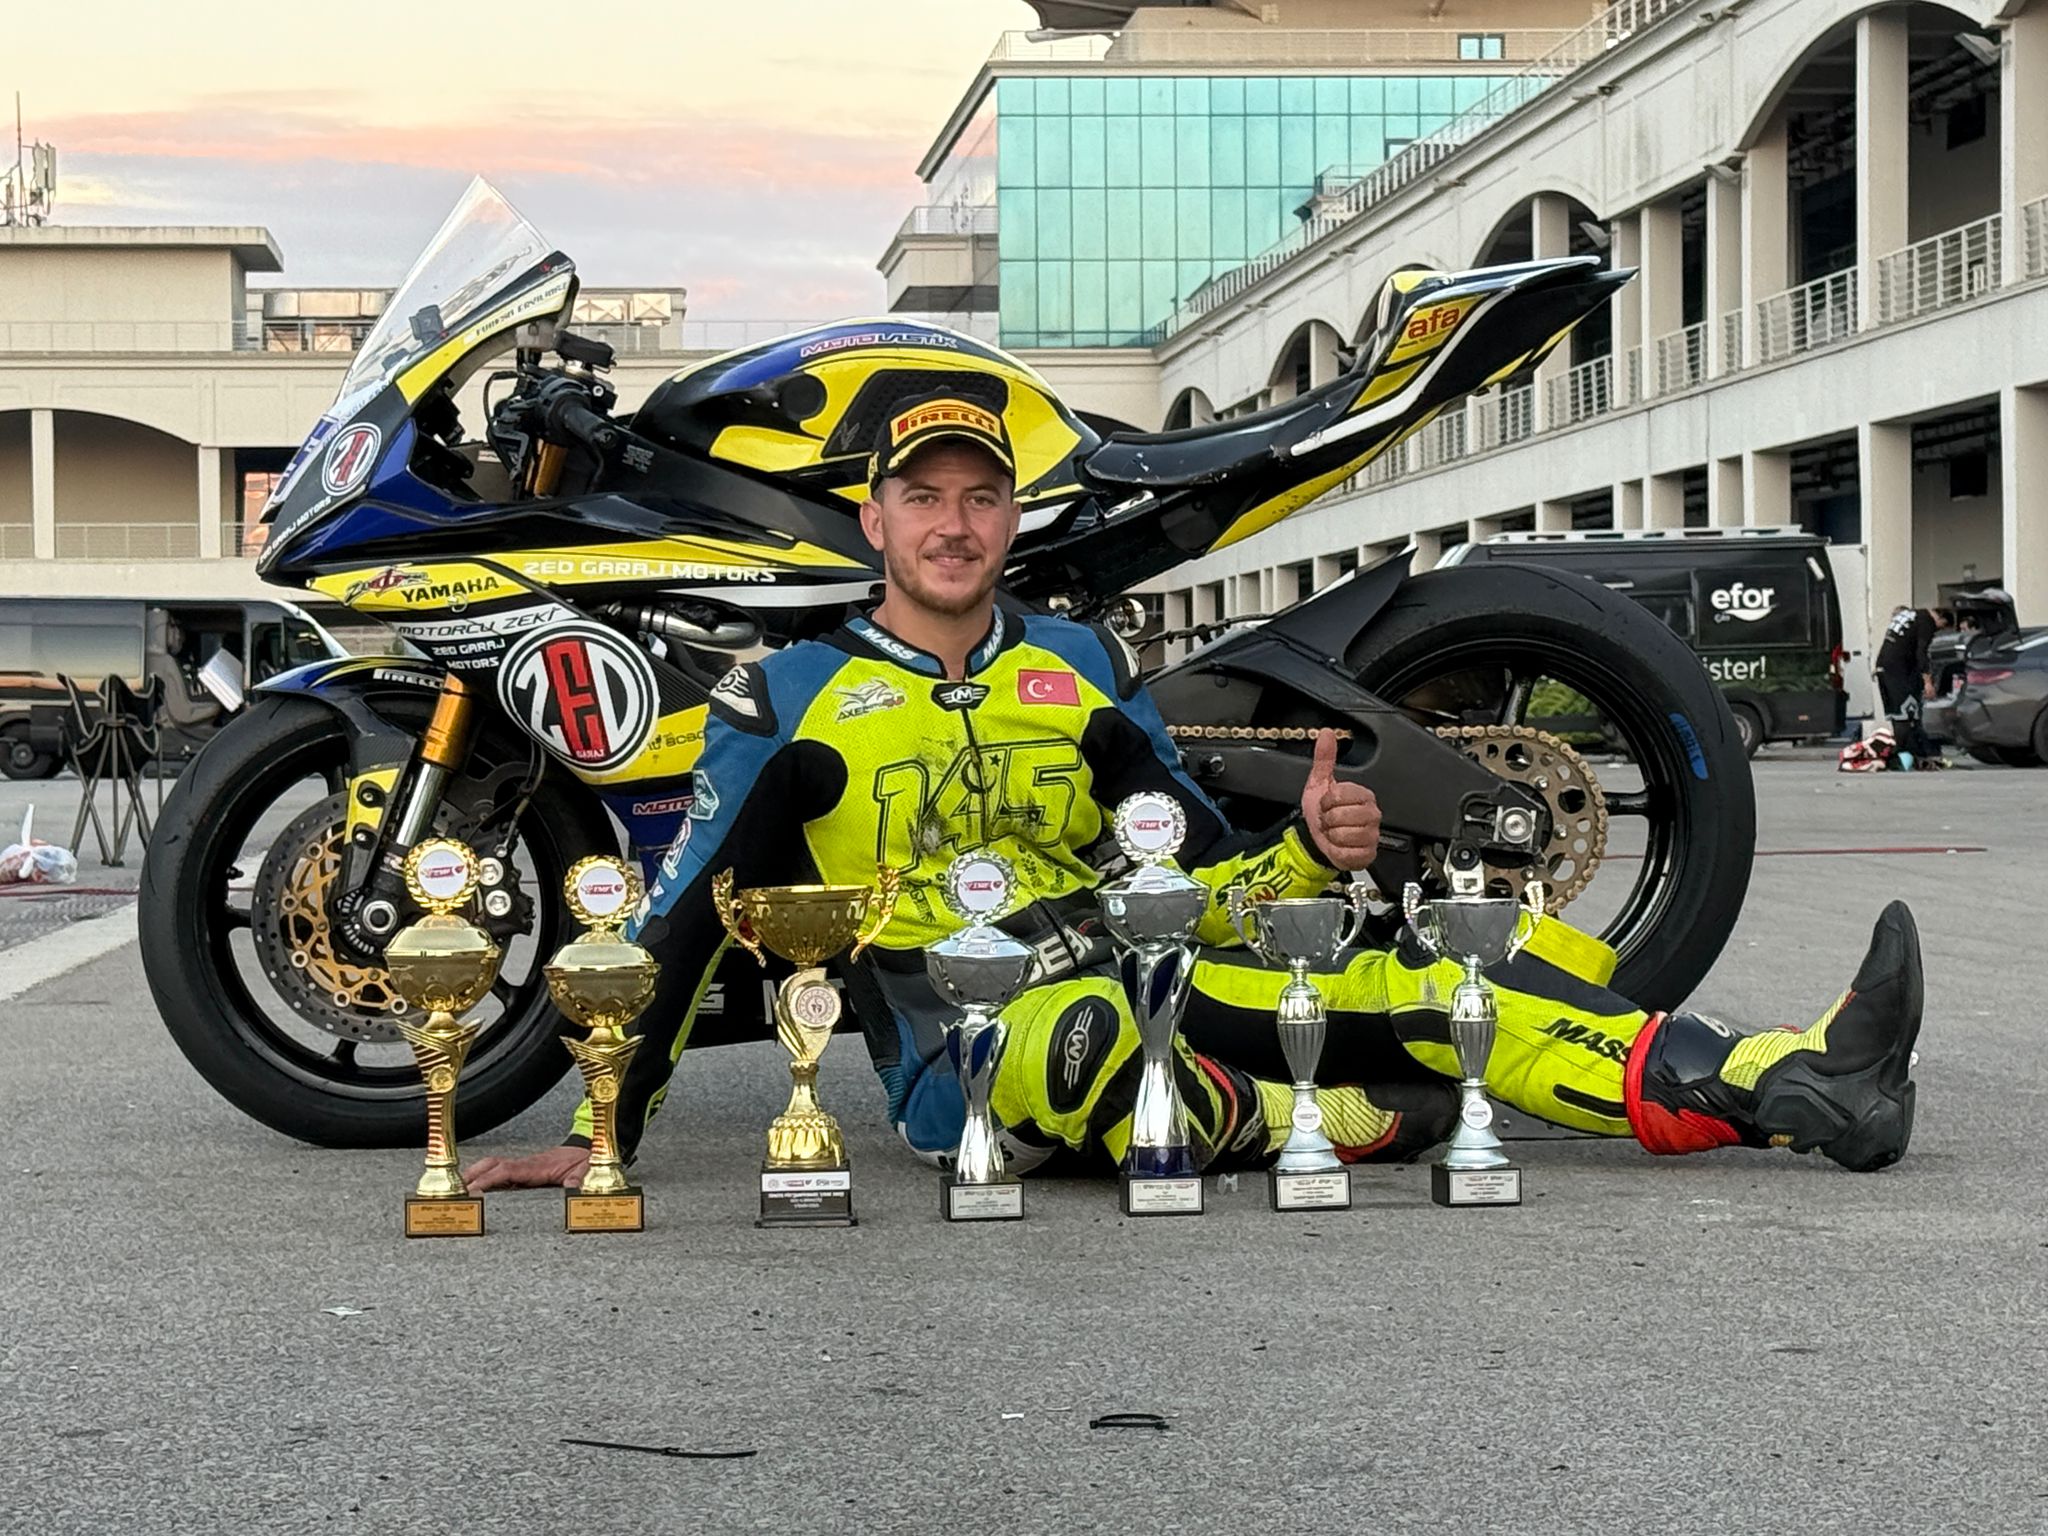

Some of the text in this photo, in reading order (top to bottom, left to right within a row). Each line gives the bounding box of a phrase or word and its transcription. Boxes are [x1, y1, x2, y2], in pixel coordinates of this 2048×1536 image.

[1408, 306, 1460, 339] afa
[897, 406, 996, 437] PIRELLI
[296, 495, 332, 527] MOTORS
[523, 561, 777, 583] ZED GARAJ MOTORS
[401, 576, 500, 603] YAMAHA
[1711, 582, 1776, 610] efor
[399, 621, 497, 637] MOTORCU
[459, 638, 506, 654] GARAJ
[859, 627, 920, 660] MASS
[446, 657, 500, 670] MOTORS
[874, 739, 1081, 873] 145
